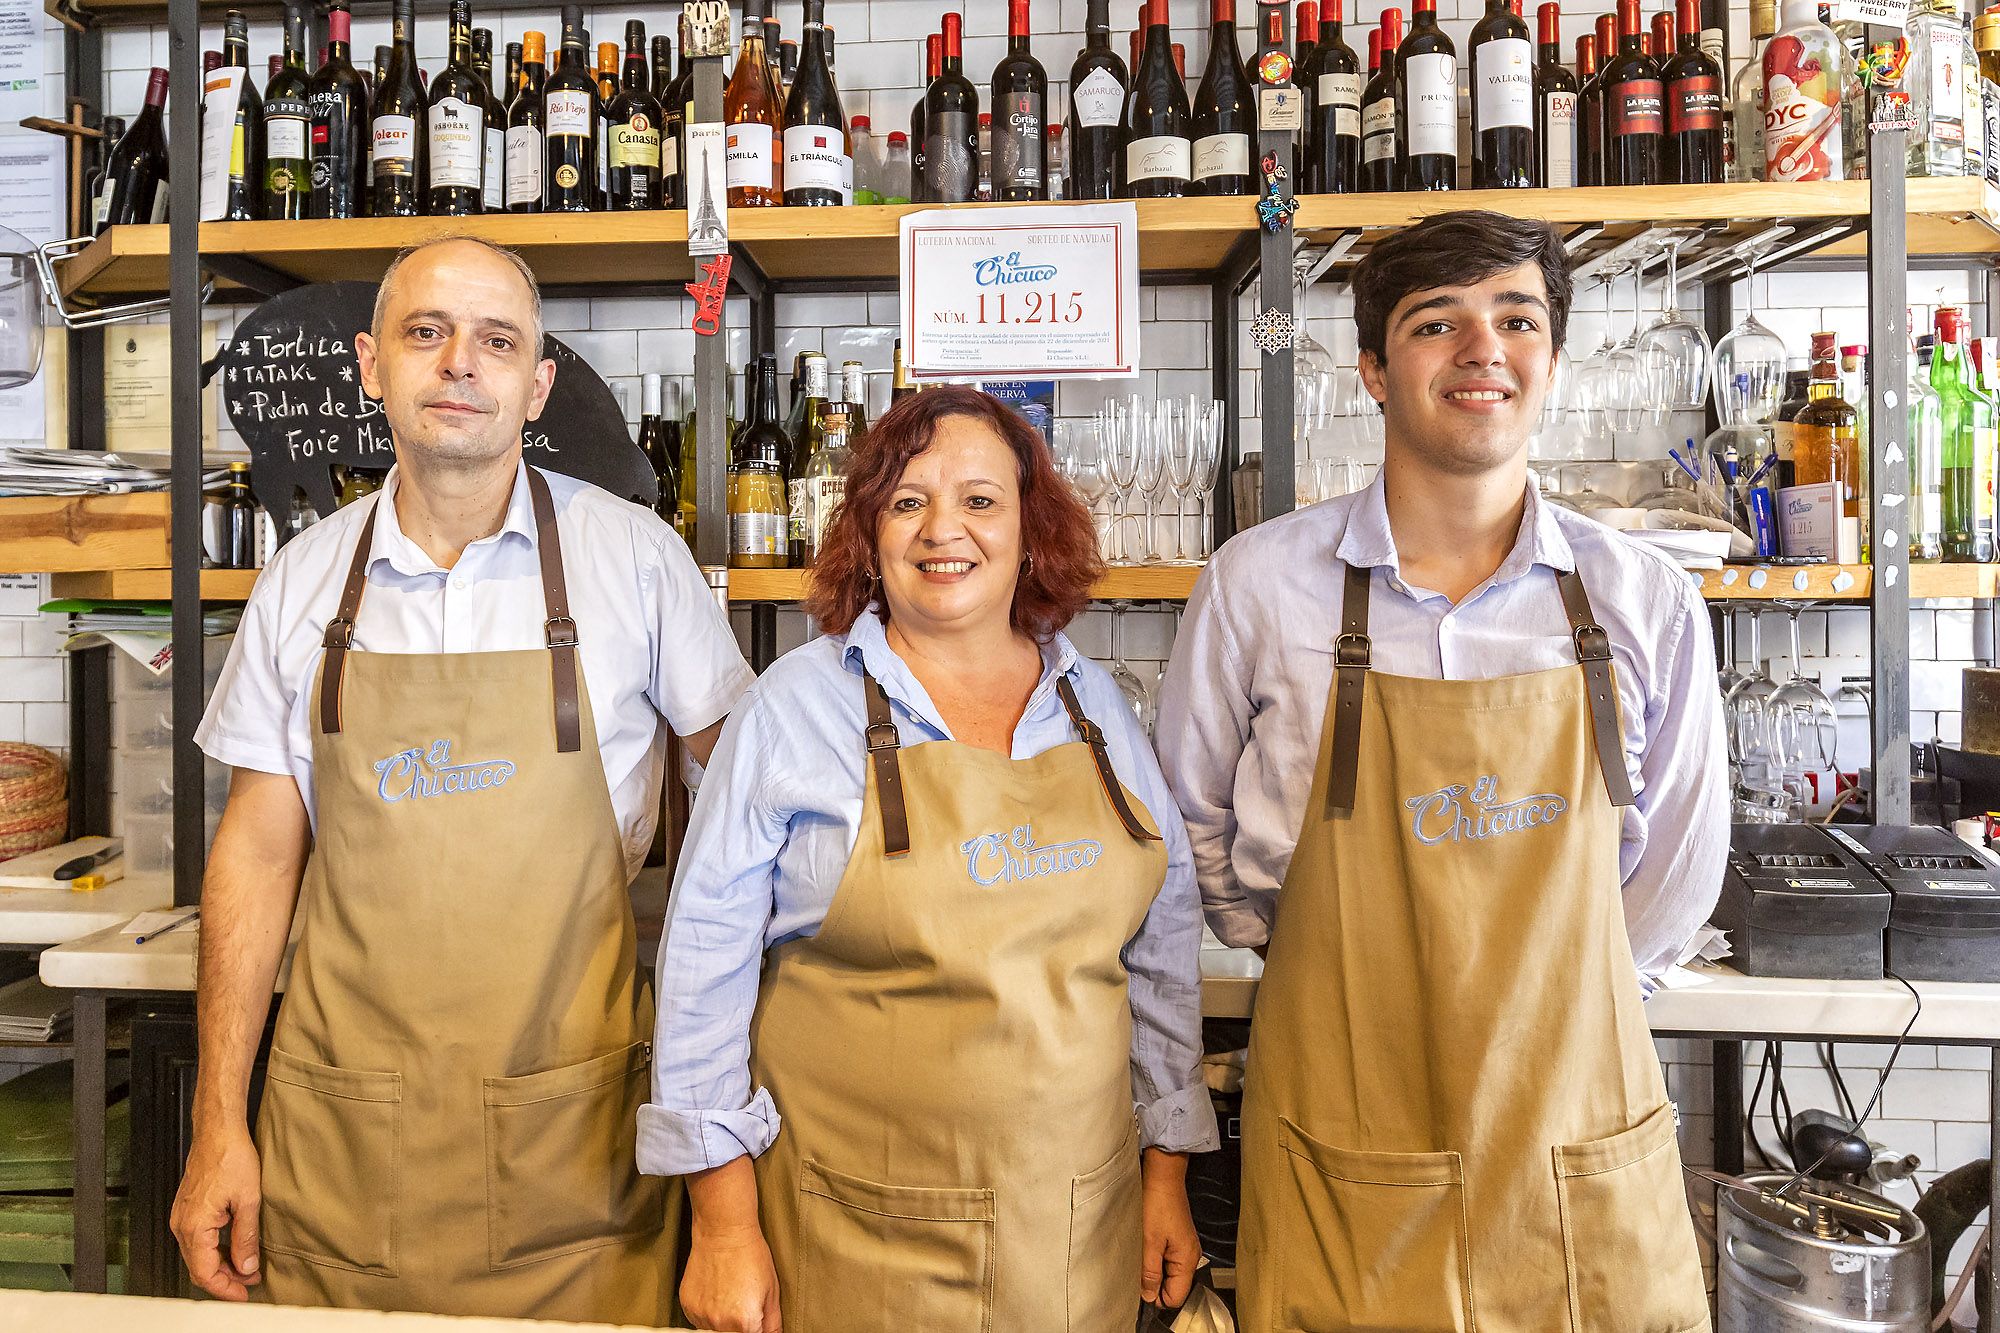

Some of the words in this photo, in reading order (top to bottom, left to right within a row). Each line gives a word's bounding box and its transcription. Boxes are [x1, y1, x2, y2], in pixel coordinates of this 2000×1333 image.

[684, 1, 730, 24] RONDA
[1860, 6, 1887, 16] FIELD
[1079, 87, 1121, 97] SAMARUCO
[1421, 94, 1453, 102] PRUNO
[550, 102, 564, 114] Río
[565, 102, 586, 115] Viejo
[1765, 103, 1806, 129] DYC
[434, 122, 469, 130] OSBORNE
[1010, 113, 1038, 126] Cortijo
[691, 129, 721, 138] paris
[1022, 123, 1038, 136] Jara
[618, 131, 659, 147] Canasta
[790, 154, 799, 162] EL
[1143, 165, 1173, 173] Barbazul
[955, 236, 996, 246] NACIONAL
[1027, 235, 1059, 245] SORTEO
[1060, 235, 1071, 244] DE
[1073, 233, 1111, 244] NAVIDAD
[1005, 251, 1020, 266] El
[973, 255, 1057, 286] Chicuco
[933, 310, 969, 324] NÚM.
[976, 291, 1083, 324] 11.215
[319, 387, 349, 418] de
[286, 429, 340, 461] Foie
[1789, 522, 1812, 536] 11.215
[425, 739, 451, 766] El
[374, 748, 516, 803] Chicuco
[1469, 775, 1498, 804] El
[1404, 783, 1569, 847] Chicuco
[1012, 824, 1036, 850] El
[960, 832, 1104, 886] Chicuco
